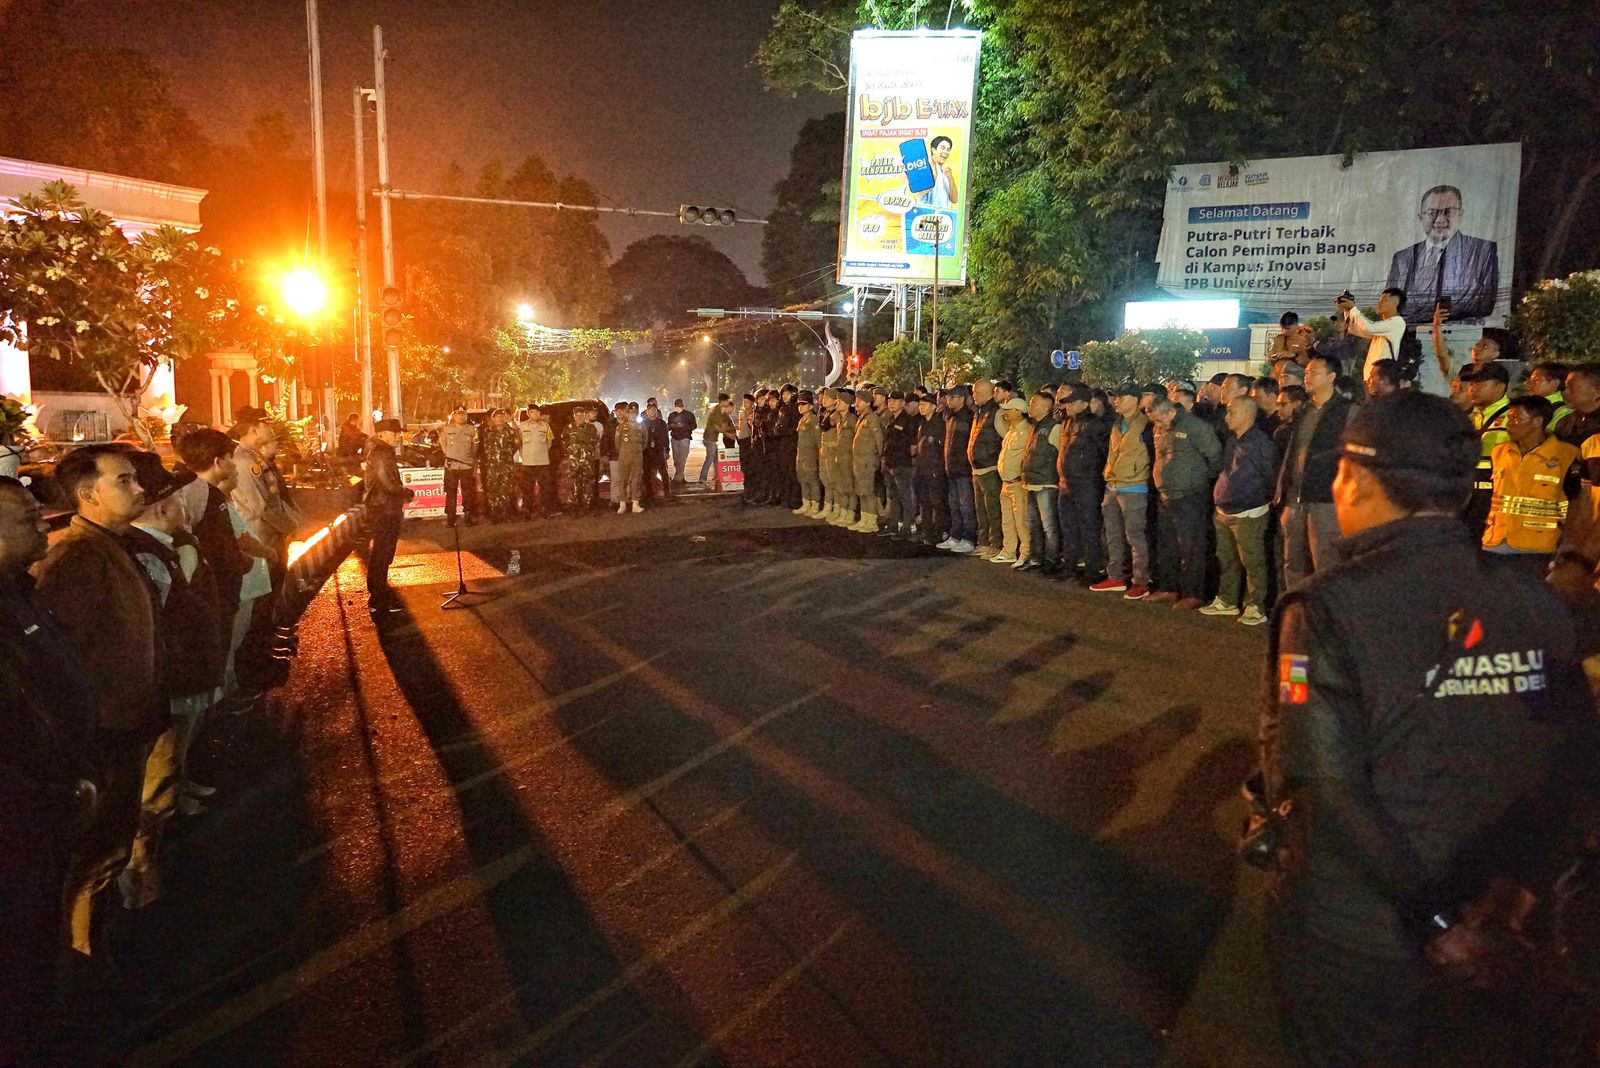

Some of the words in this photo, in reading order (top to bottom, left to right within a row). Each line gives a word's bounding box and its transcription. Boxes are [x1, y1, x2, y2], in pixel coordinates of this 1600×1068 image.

[860, 94, 912, 126] bjb
[916, 98, 969, 119] E-TAX
[906, 158, 927, 171] DIGI
[1199, 207, 1249, 219] Selamat
[1253, 206, 1299, 218] Datang
[1187, 228, 1271, 242] Putra-Putri
[1275, 225, 1336, 240] Terbaik
[1186, 245, 1228, 258] Calon
[1232, 243, 1311, 258] Pemimpin
[1316, 242, 1376, 257] Bangsa
[1185, 262, 1198, 274] di
[1203, 261, 1264, 274] Kampus
[1268, 259, 1326, 272] Inovasi
[1184, 278, 1209, 290] IPB
[1213, 276, 1293, 291] University
[722, 464, 742, 472] sma
[414, 485, 447, 497] martf
[1513, 674, 1546, 692] DE
